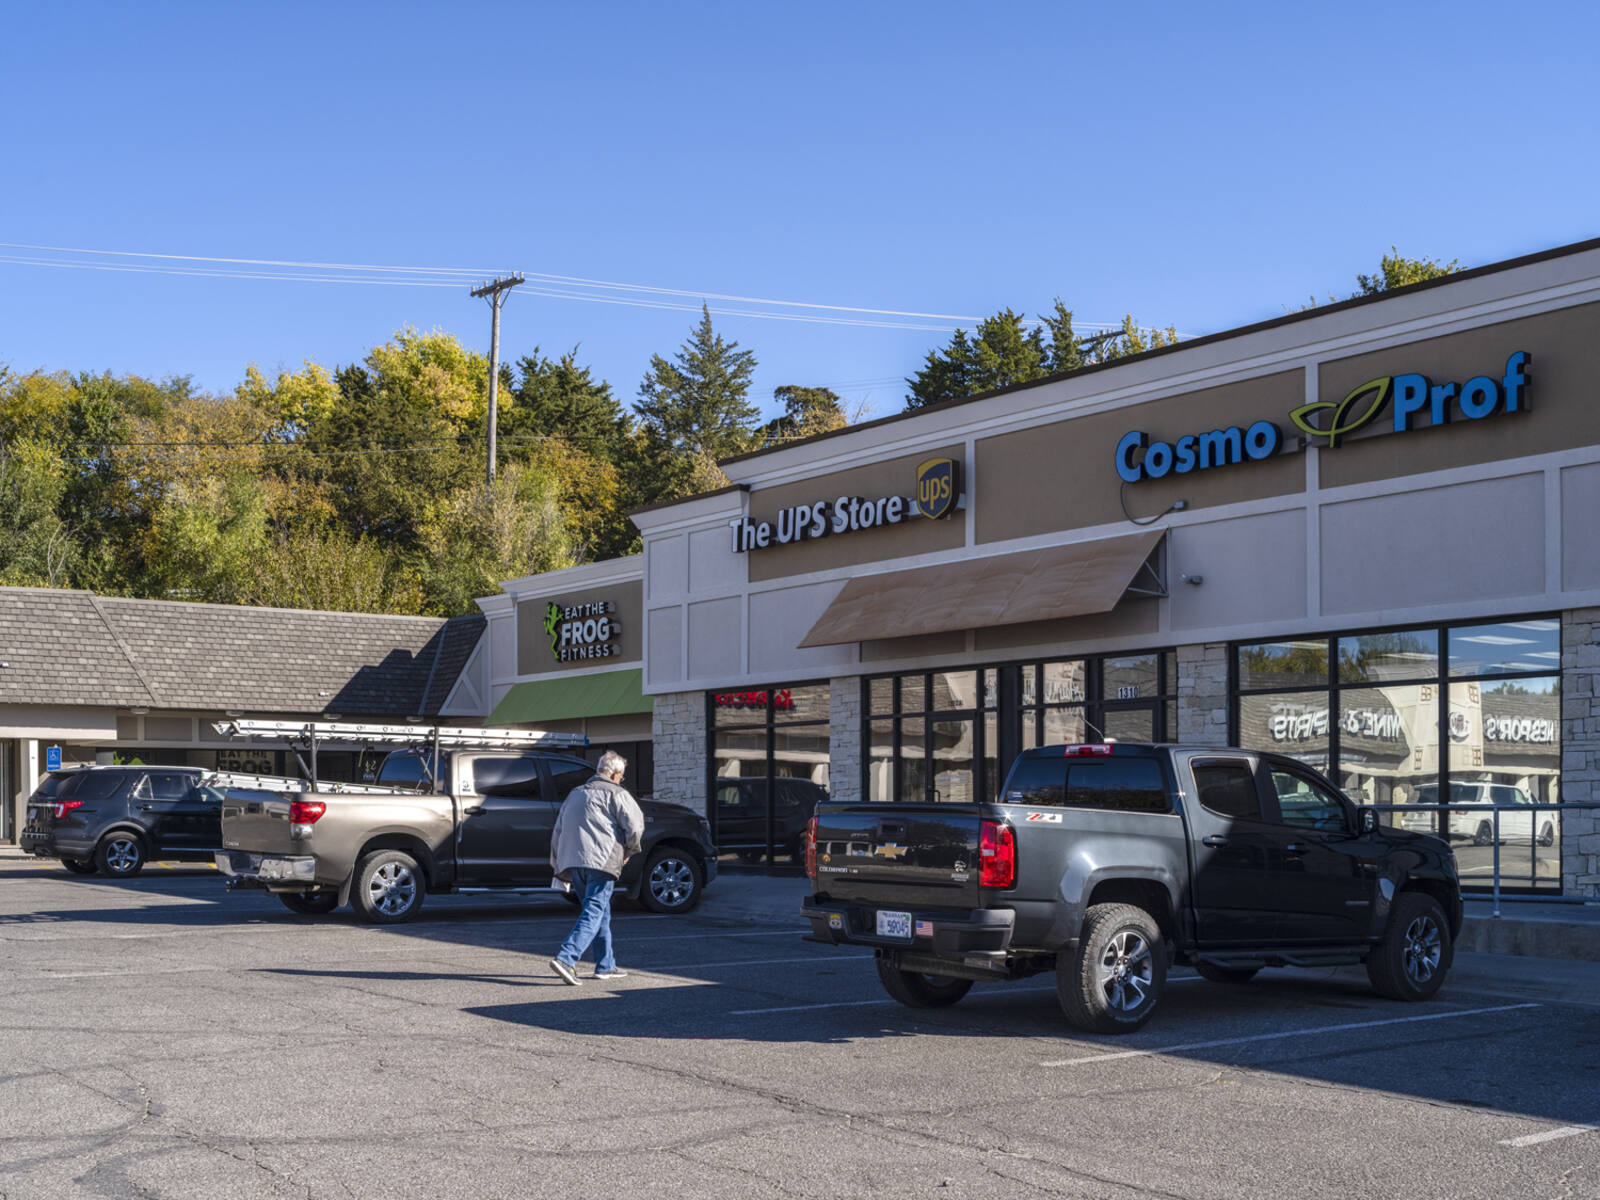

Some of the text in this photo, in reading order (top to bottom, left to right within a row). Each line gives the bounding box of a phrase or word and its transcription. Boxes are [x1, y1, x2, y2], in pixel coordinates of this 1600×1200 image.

[1115, 350, 1528, 482] Cosmo Prof
[920, 475, 950, 511] ups
[728, 496, 903, 552] The UPS Store
[564, 601, 605, 619] EAT THE
[561, 616, 610, 647] FROG
[561, 644, 609, 661] FITNESS
[1119, 686, 1139, 699] 1310
[219, 759, 273, 775] FROG
